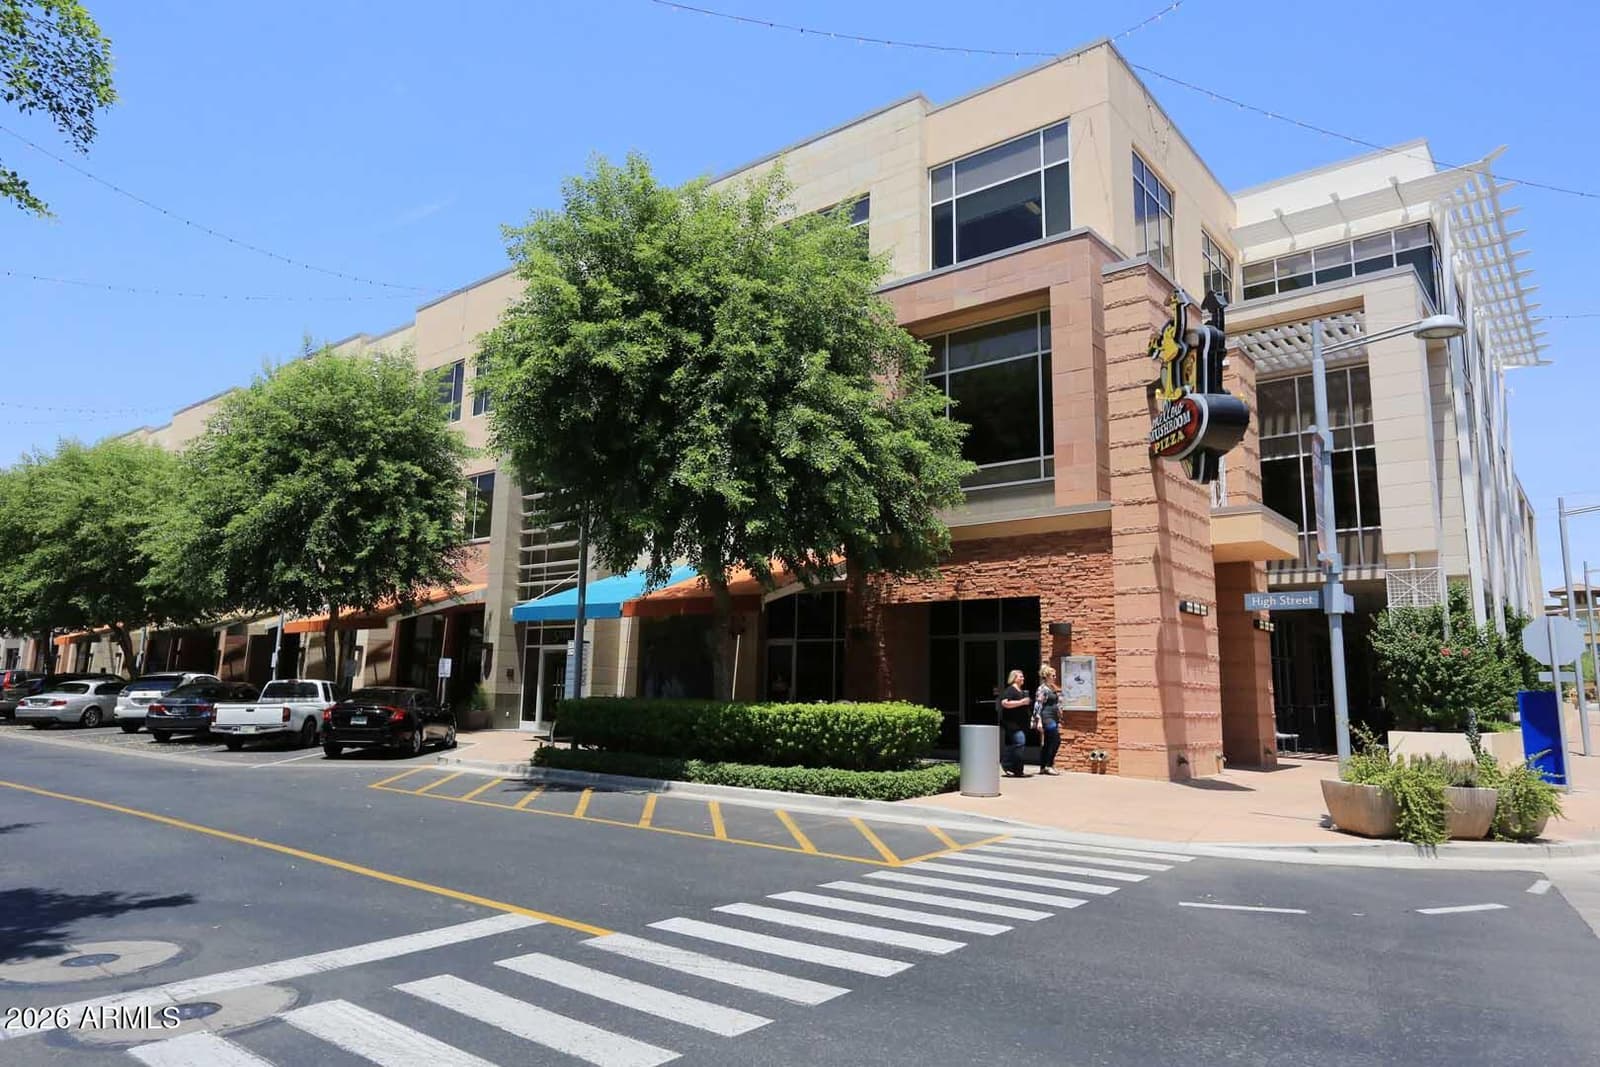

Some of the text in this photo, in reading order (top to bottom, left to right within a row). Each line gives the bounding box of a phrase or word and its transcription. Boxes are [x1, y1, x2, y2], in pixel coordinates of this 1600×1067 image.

[1154, 430, 1186, 454] PIZZA
[1252, 595, 1313, 608] High Street
